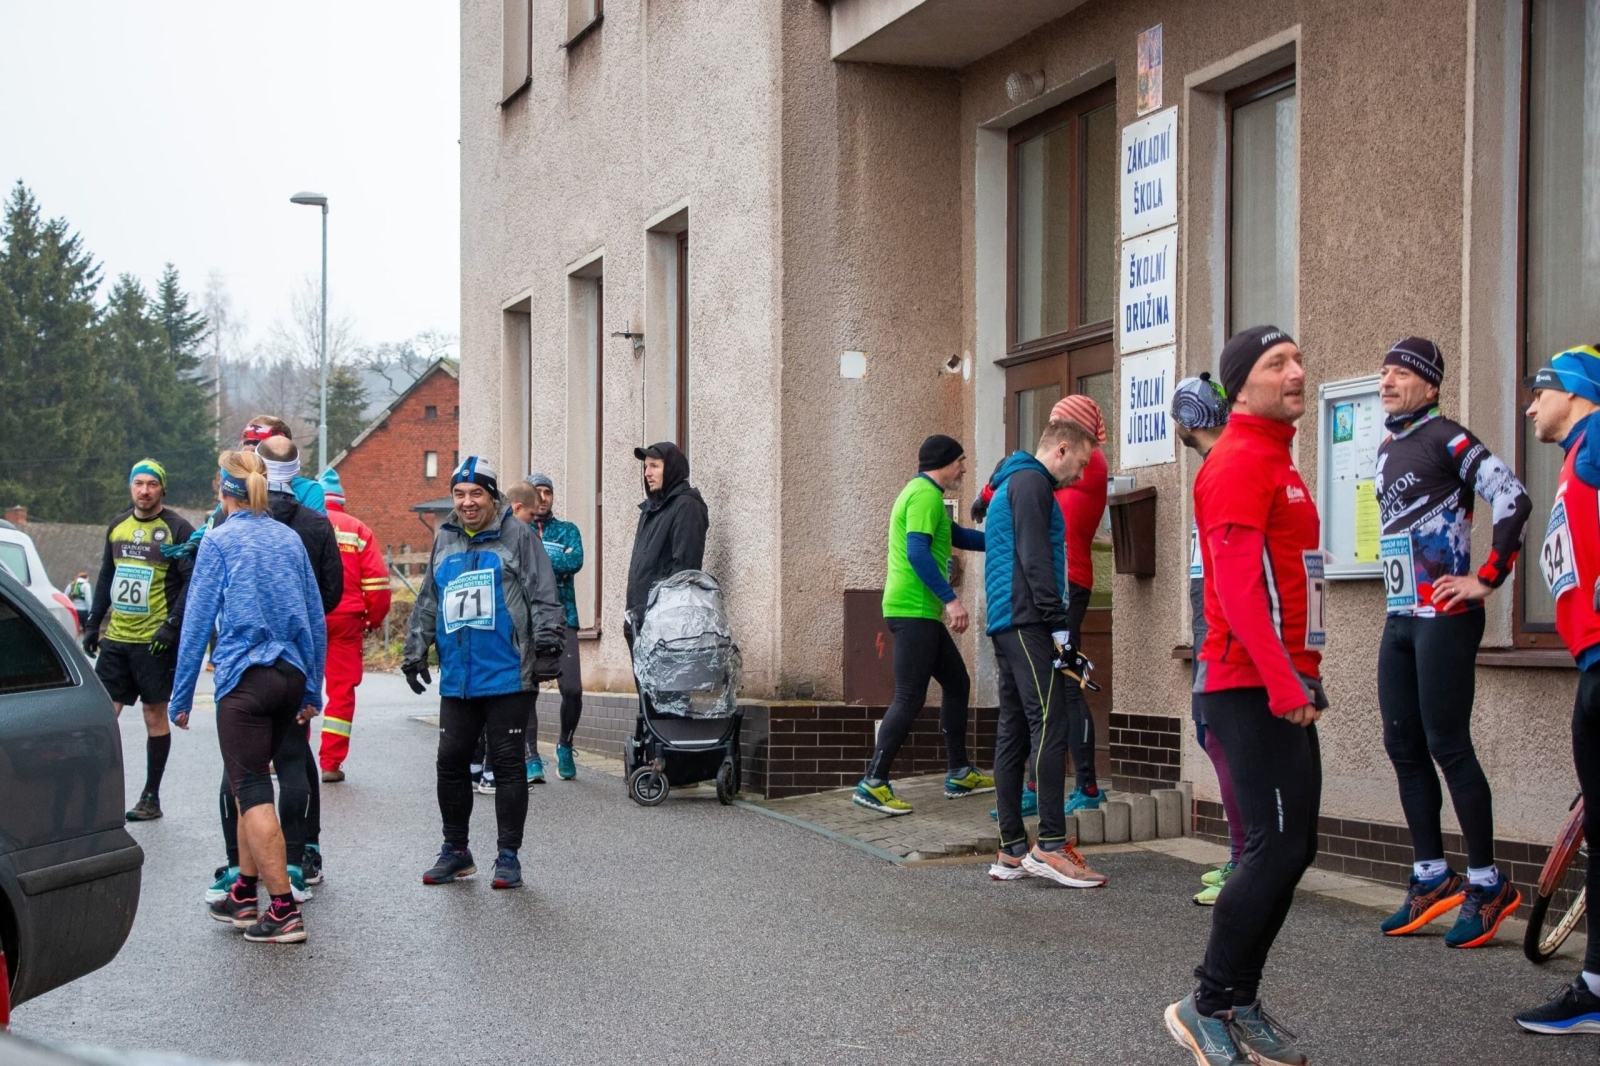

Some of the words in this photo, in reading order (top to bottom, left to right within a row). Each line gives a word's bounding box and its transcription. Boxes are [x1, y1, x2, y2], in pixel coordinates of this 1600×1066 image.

[1127, 124, 1171, 174] ZÁKLADNÍ
[1134, 178, 1163, 215] ŠKOLA
[1129, 245, 1167, 289] ŠKOLNÍ
[1126, 292, 1170, 334] DRUŽINA
[1130, 369, 1166, 410] ŠKOLNÍ
[1127, 409, 1167, 445] JÍDELNA
[1545, 533, 1564, 586] 34
[117, 579, 142, 604] 26
[455, 589, 482, 618] 71
